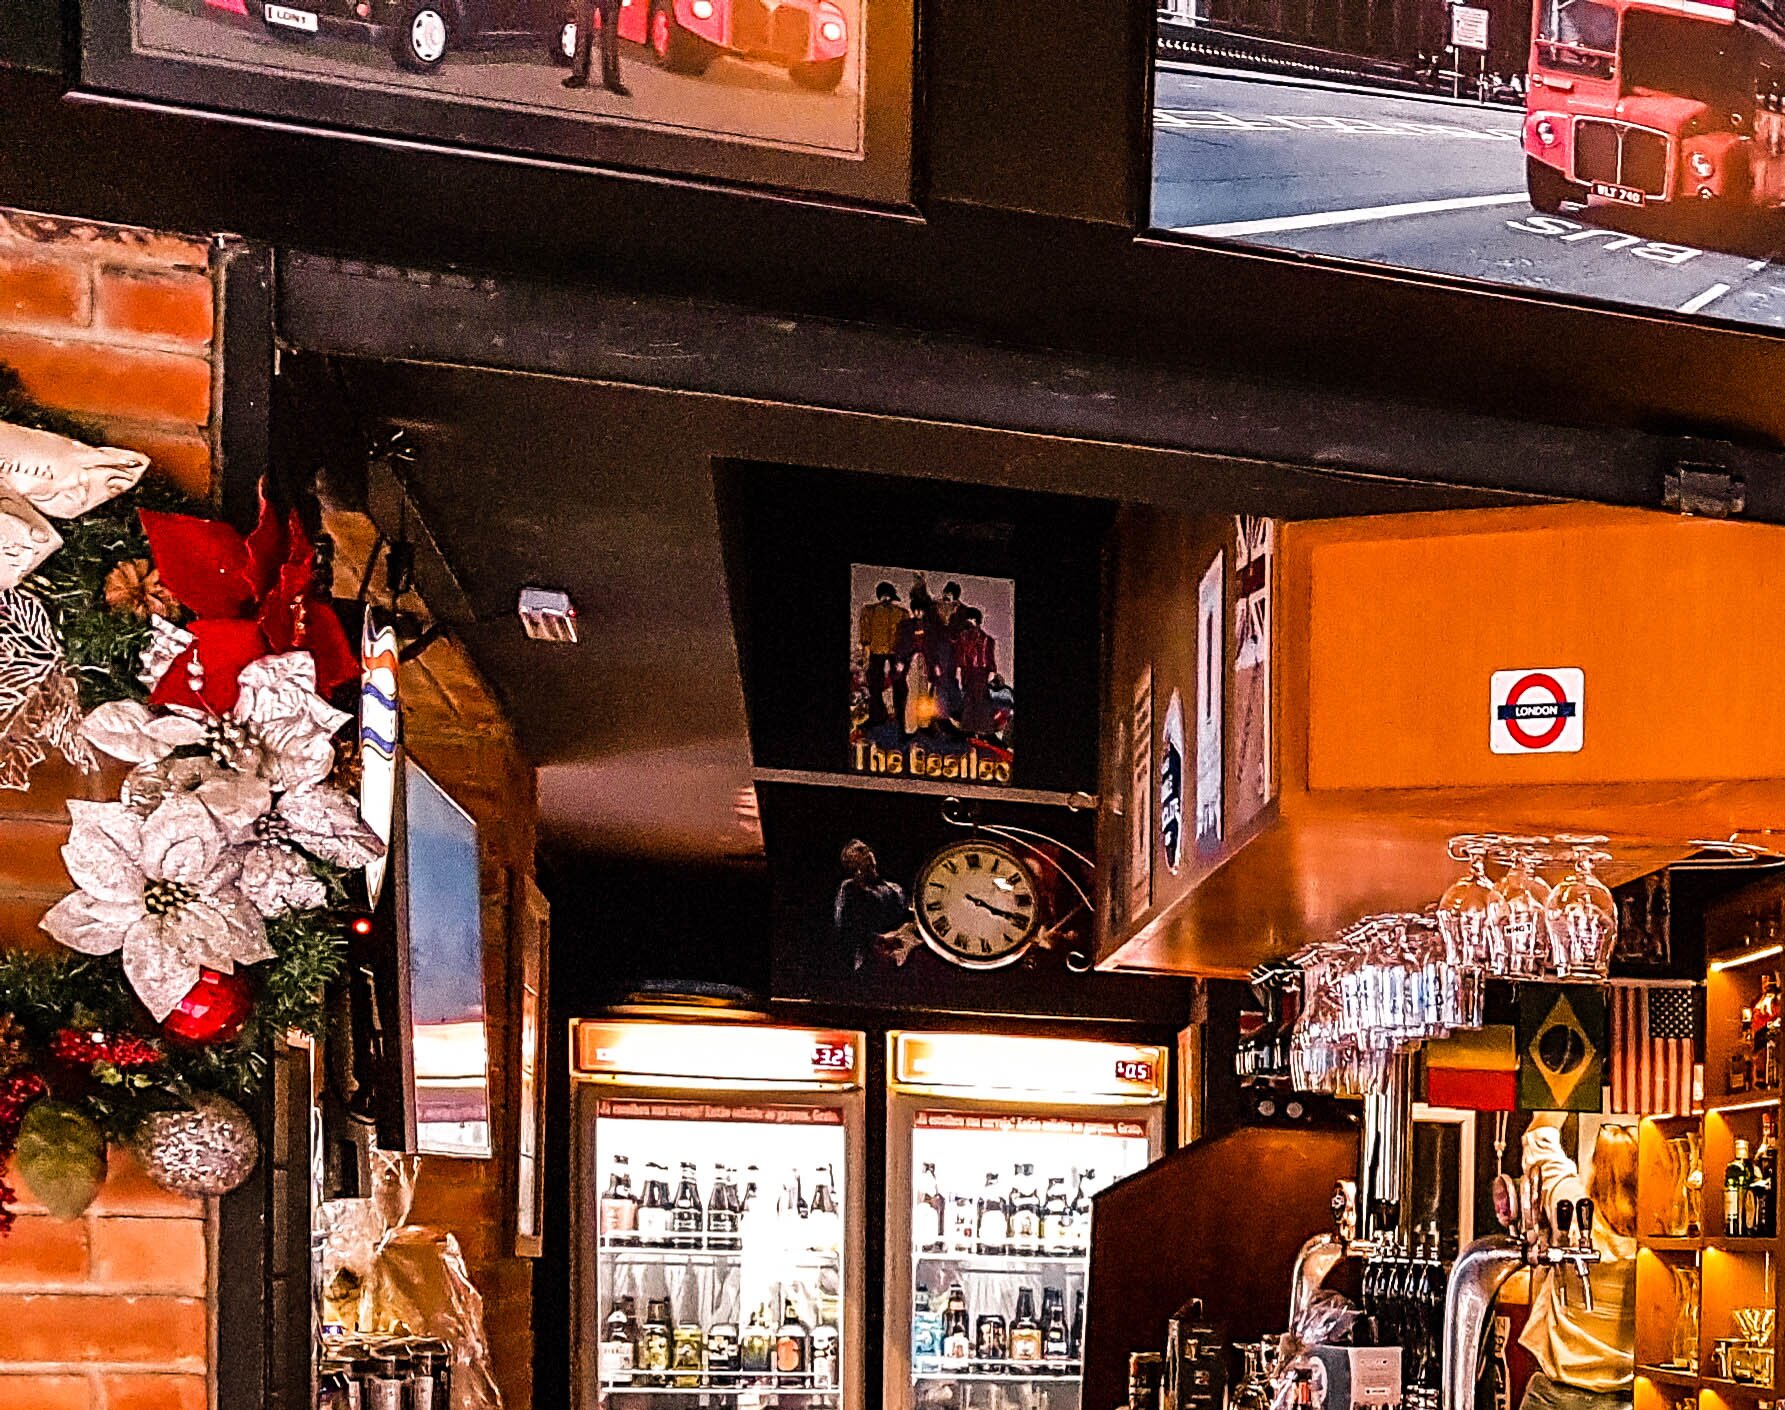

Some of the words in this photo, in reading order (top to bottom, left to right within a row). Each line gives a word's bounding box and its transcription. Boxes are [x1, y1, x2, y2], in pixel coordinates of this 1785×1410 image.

[1505, 216, 1704, 264] BUS
[1515, 705, 1559, 717] LONDON
[851, 739, 903, 774] The
